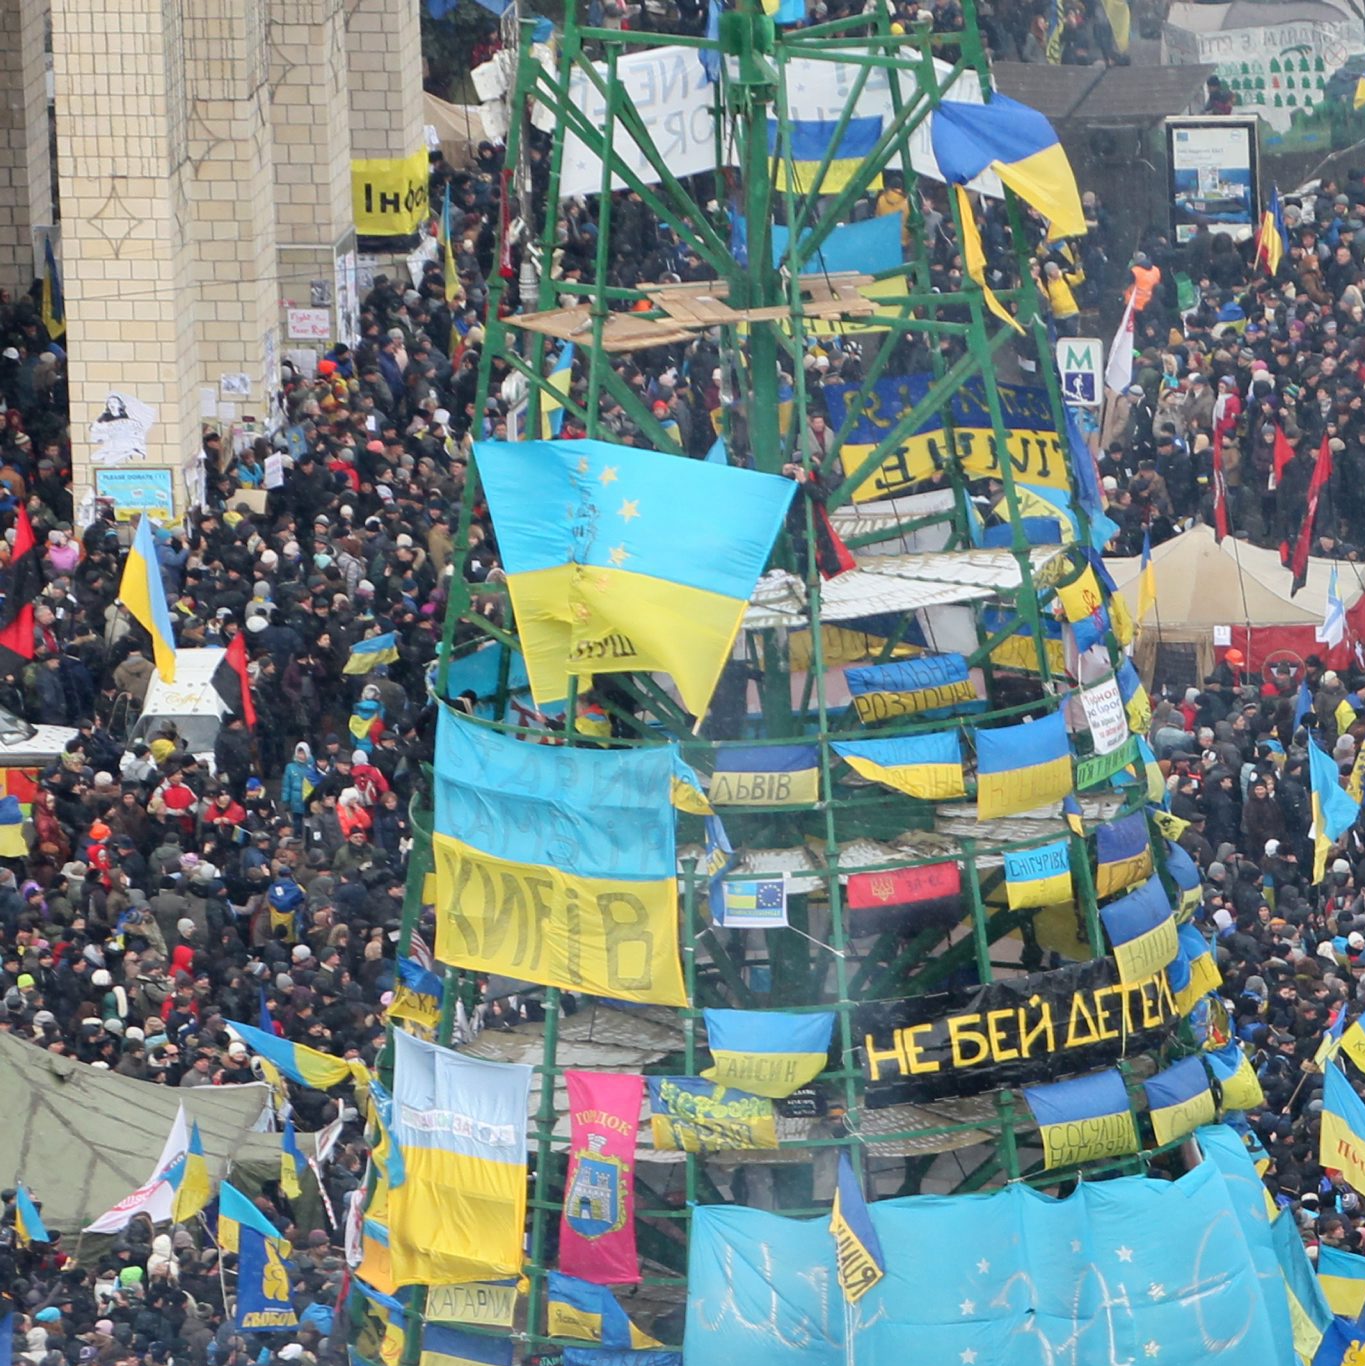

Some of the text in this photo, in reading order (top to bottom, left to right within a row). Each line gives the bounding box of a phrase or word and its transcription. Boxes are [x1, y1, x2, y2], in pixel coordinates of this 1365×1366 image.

[711, 772, 792, 801] ЛЬВІВ
[864, 1023, 940, 1082] НЕ
[949, 994, 1056, 1068] БЕЙ
